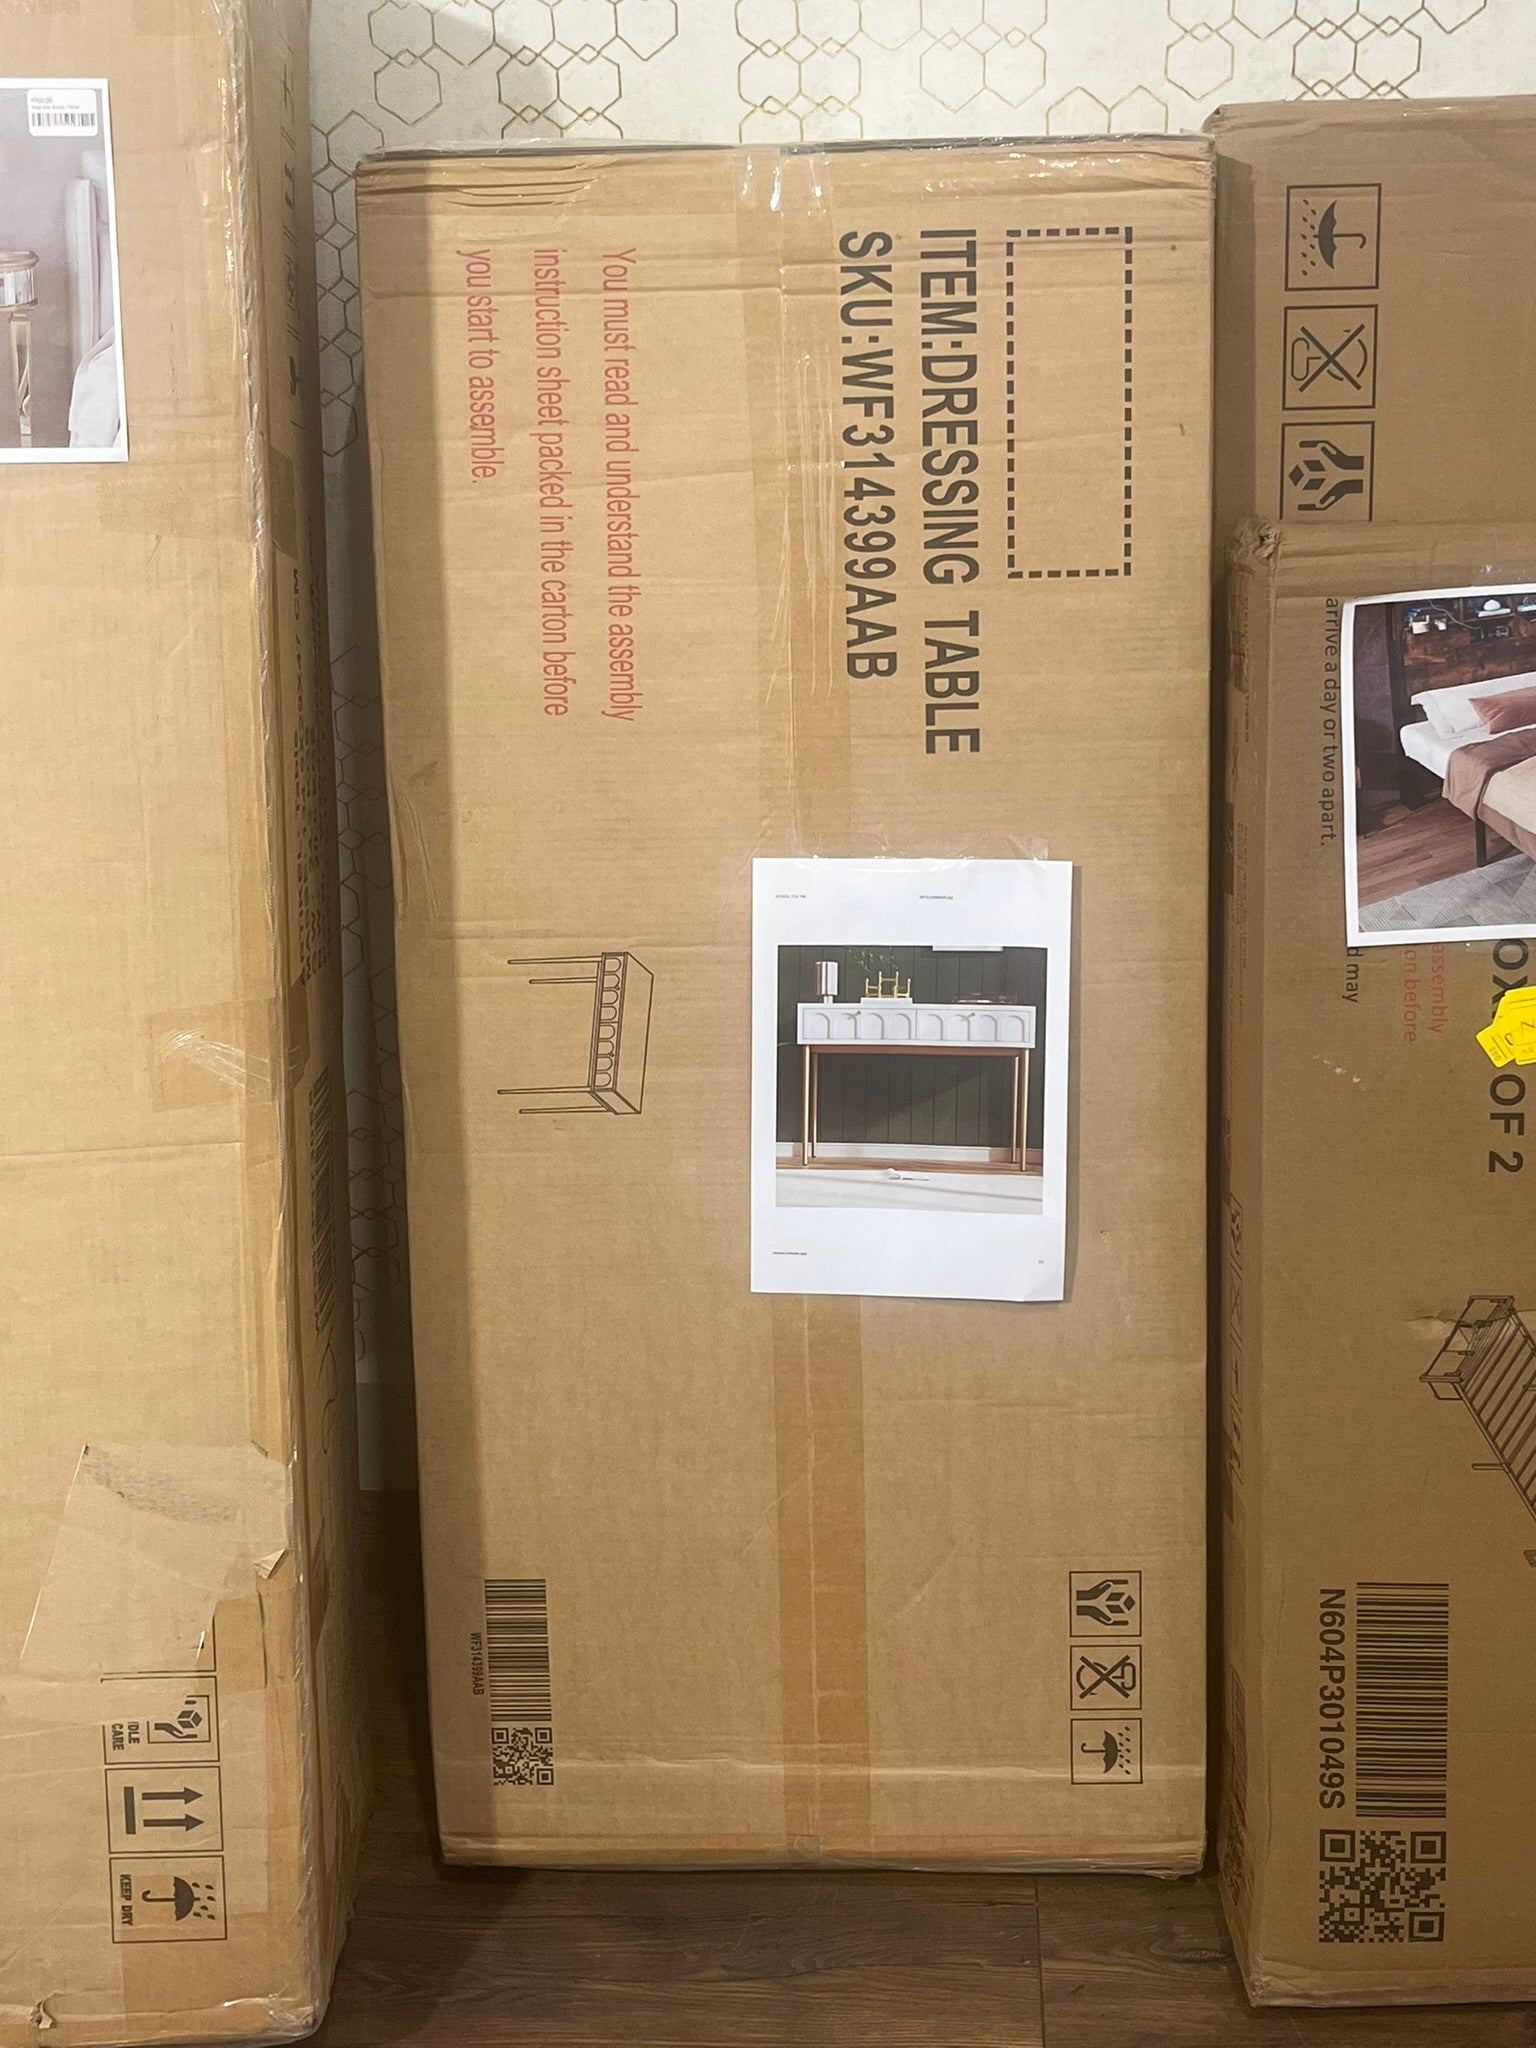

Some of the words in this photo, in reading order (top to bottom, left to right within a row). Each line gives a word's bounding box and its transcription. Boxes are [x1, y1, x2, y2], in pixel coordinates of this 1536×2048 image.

[456, 248, 491, 288] you
[602, 247, 637, 292] You
[467, 295, 500, 343] start
[533, 249, 571, 359] instruction
[603, 299, 637, 352] must
[468, 349, 500, 369] to
[604, 358, 639, 406] read
[536, 366, 570, 426] sheet
[919, 229, 980, 586] ITEM:DRESSING
[469, 376, 505, 484] assemble.
[605, 413, 639, 452] and
[838, 230, 898, 680] SKU:WF314399AAB
[529, 432, 573, 508] packed
[540, 515, 573, 533] in
[605, 460, 642, 578] understand
[540, 540, 574, 573] the
[541, 579, 574, 644] carton
[608, 584, 642, 617] the
[1324, 598, 1339, 656] arrive
[543, 651, 577, 716] before
[601, 623, 643, 721] assembly
[924, 610, 981, 755] TABLE
[1324, 662, 1338, 673] a
[1319, 678, 1341, 714] day
[1323, 718, 1337, 740] or
[1322, 744, 1338, 783] two
[1318, 787, 1337, 847] apart.
[1341, 963, 1360, 1004] may
[1403, 979, 1423, 1043] before
[1489, 1073, 1527, 1136] OF
[1488, 1150, 1525, 1173] 2
[470, 1631, 485, 1695] WF314399AAB
[1318, 1587, 1347, 1809] N604P301049S
[111, 1722, 125, 1751] CARE
[119, 1873, 132, 1901] KEEP
[120, 1905, 134, 1926] DRY
